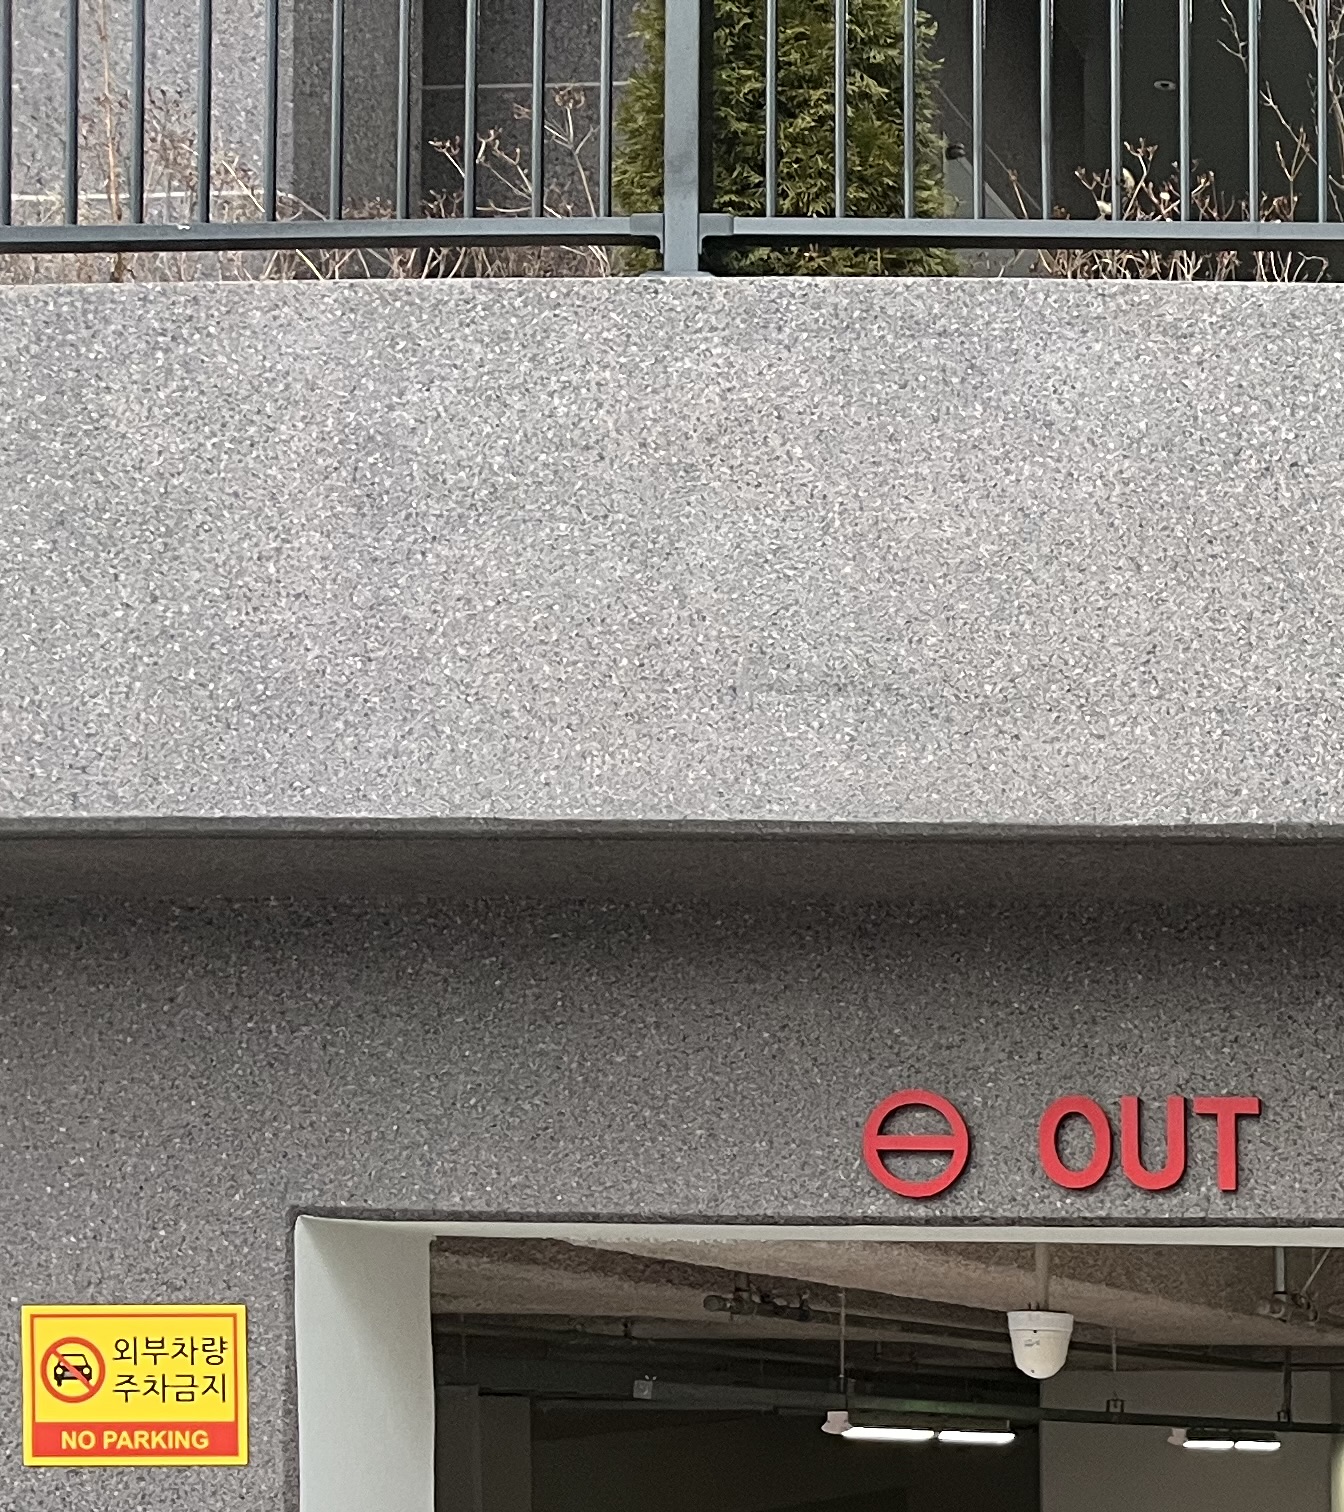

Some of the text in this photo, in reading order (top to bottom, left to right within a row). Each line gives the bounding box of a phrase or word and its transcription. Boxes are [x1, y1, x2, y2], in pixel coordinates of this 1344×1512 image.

[1038, 1094, 1261, 1192] OUT
[112, 1336, 228, 1366] 외부차량
[112, 1373, 226, 1403] 주차금지
[61, 1430, 210, 1450] NO PARKING
